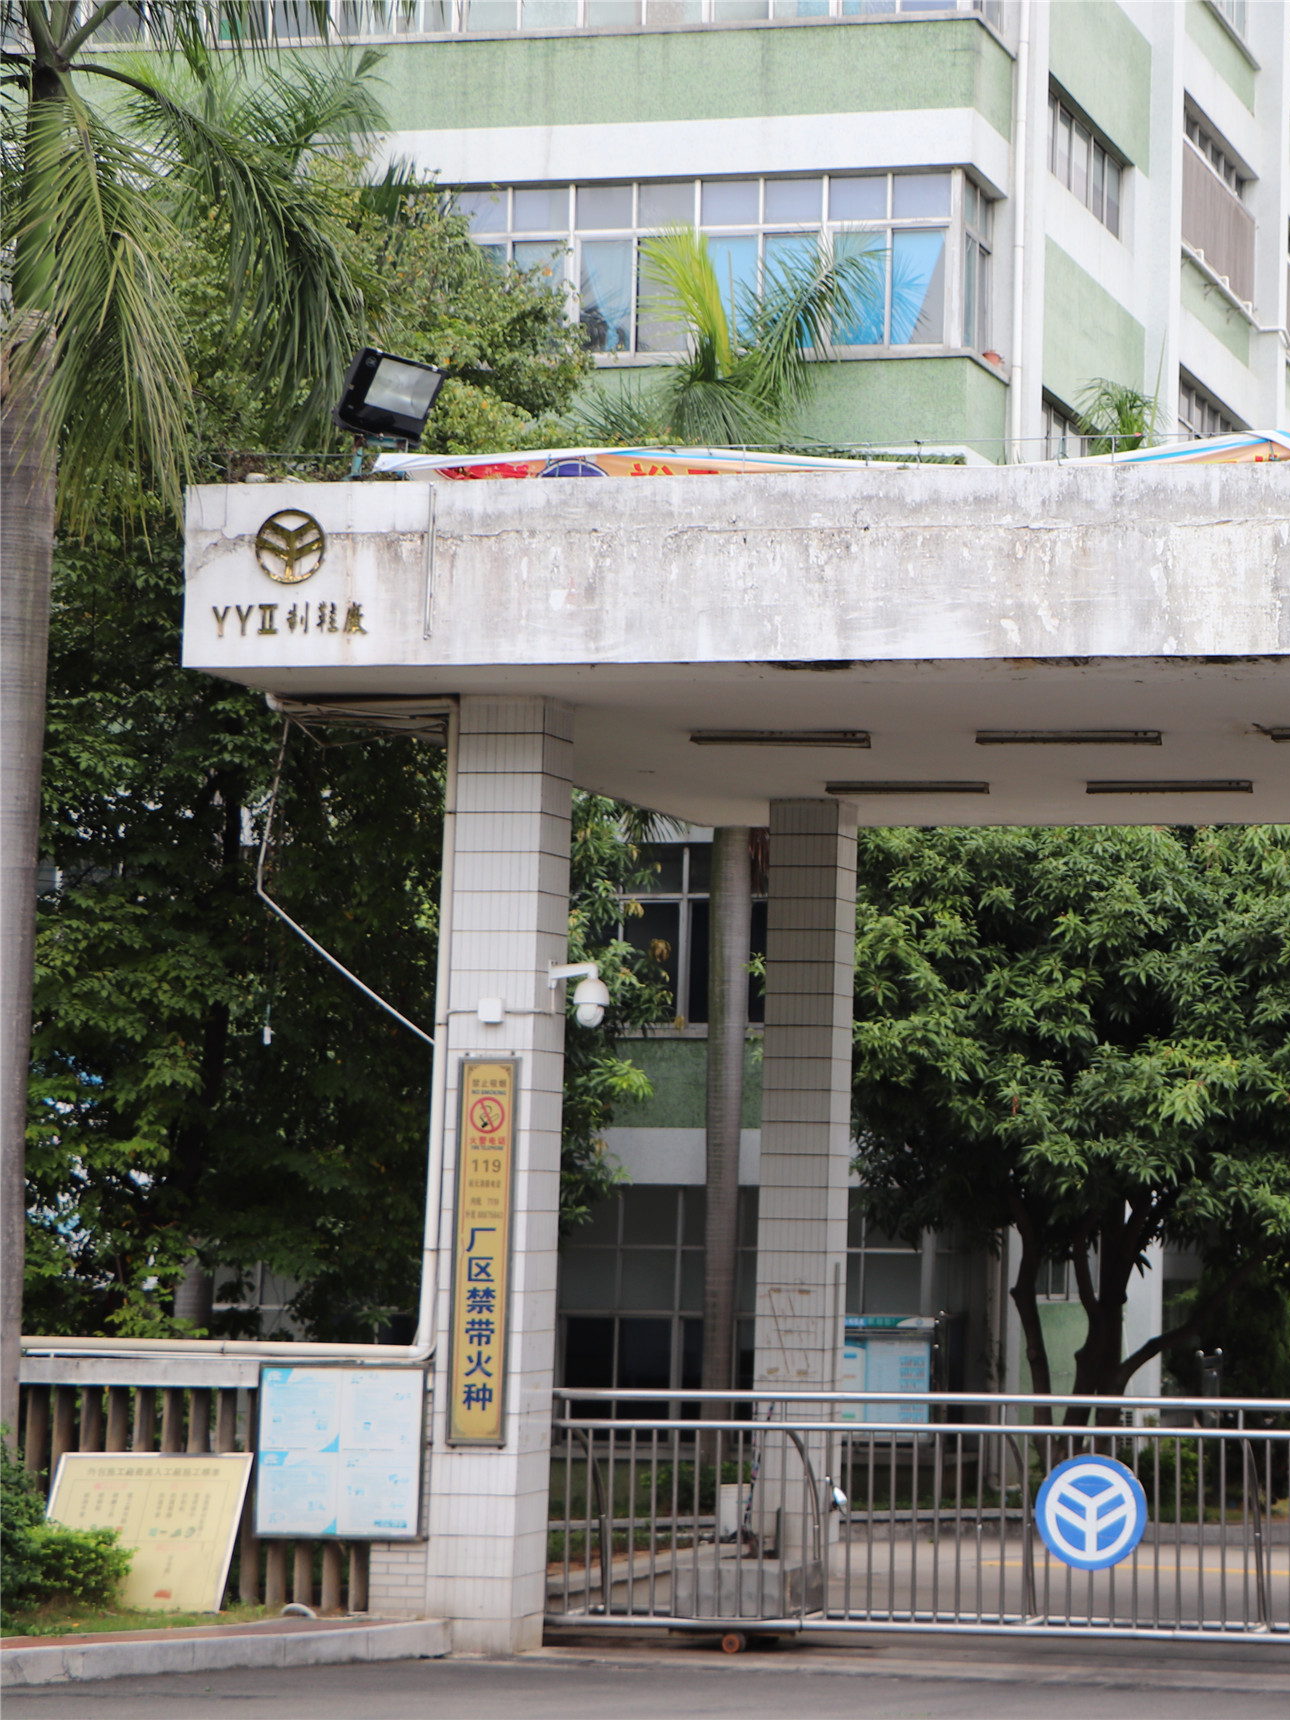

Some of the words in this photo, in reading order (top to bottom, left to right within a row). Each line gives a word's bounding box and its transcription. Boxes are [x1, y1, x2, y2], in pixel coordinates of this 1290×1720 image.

[472, 1158, 502, 1173] 119
[463, 1227, 496, 1411] 厂区禁带火种
